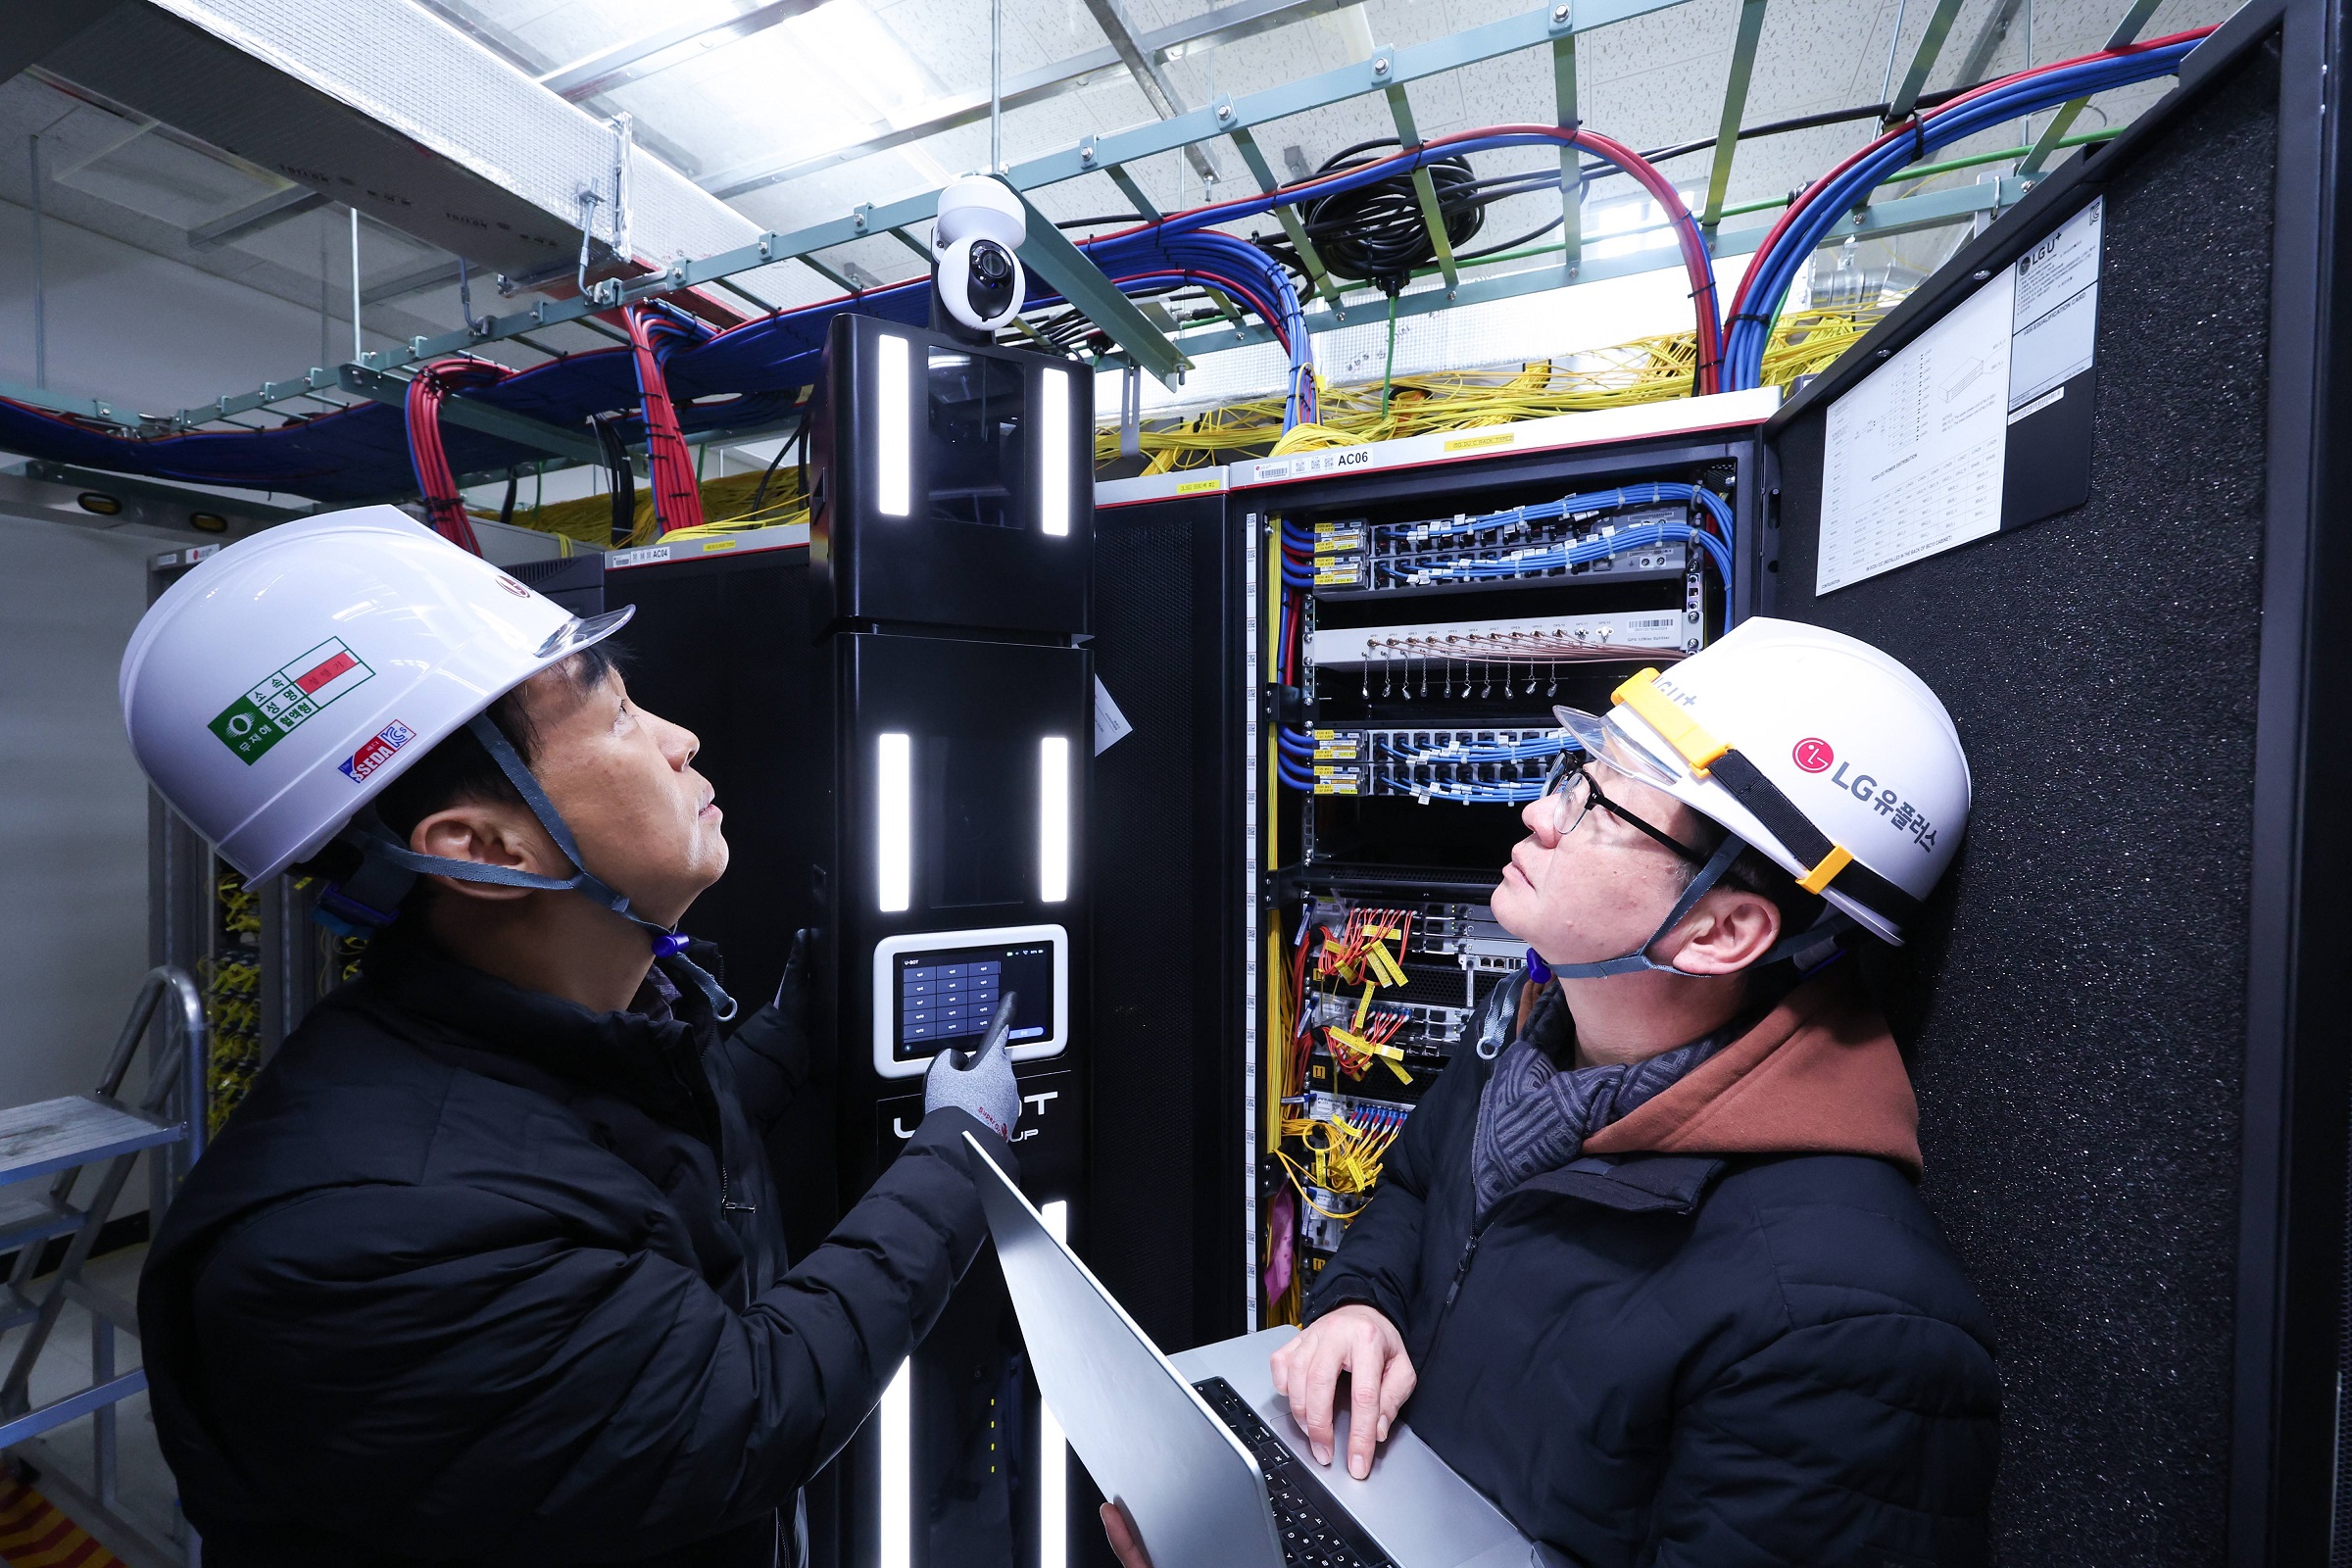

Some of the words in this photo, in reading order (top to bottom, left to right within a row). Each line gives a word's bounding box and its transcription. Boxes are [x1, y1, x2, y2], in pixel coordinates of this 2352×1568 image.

[1338, 451, 1368, 466] AC06
[653, 549, 668, 559] AC04
[350, 745, 394, 782] SSEDA
[1831, 760, 1937, 854] LG유플러스
